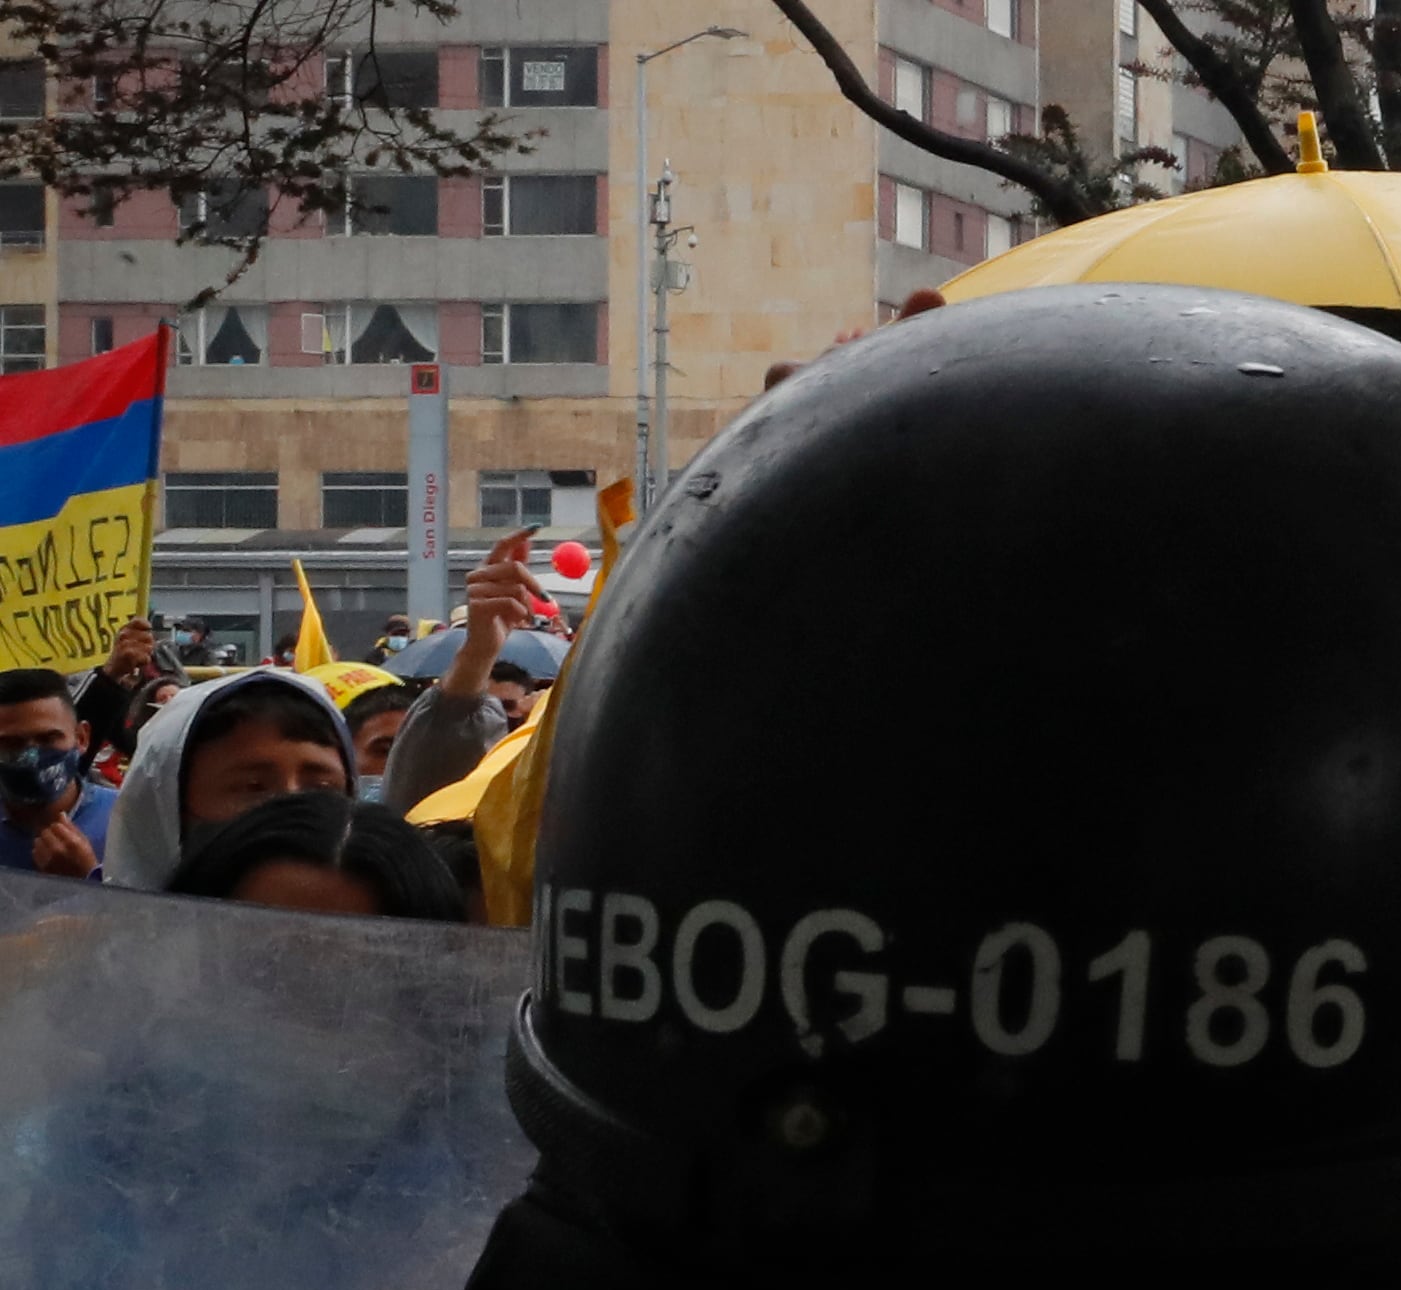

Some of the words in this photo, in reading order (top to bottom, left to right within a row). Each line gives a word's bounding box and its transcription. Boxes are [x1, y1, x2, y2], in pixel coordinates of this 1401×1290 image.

[423, 473, 439, 524] Diego
[423, 529, 436, 559] San
[538, 882, 1372, 1071] EBOG-0186
